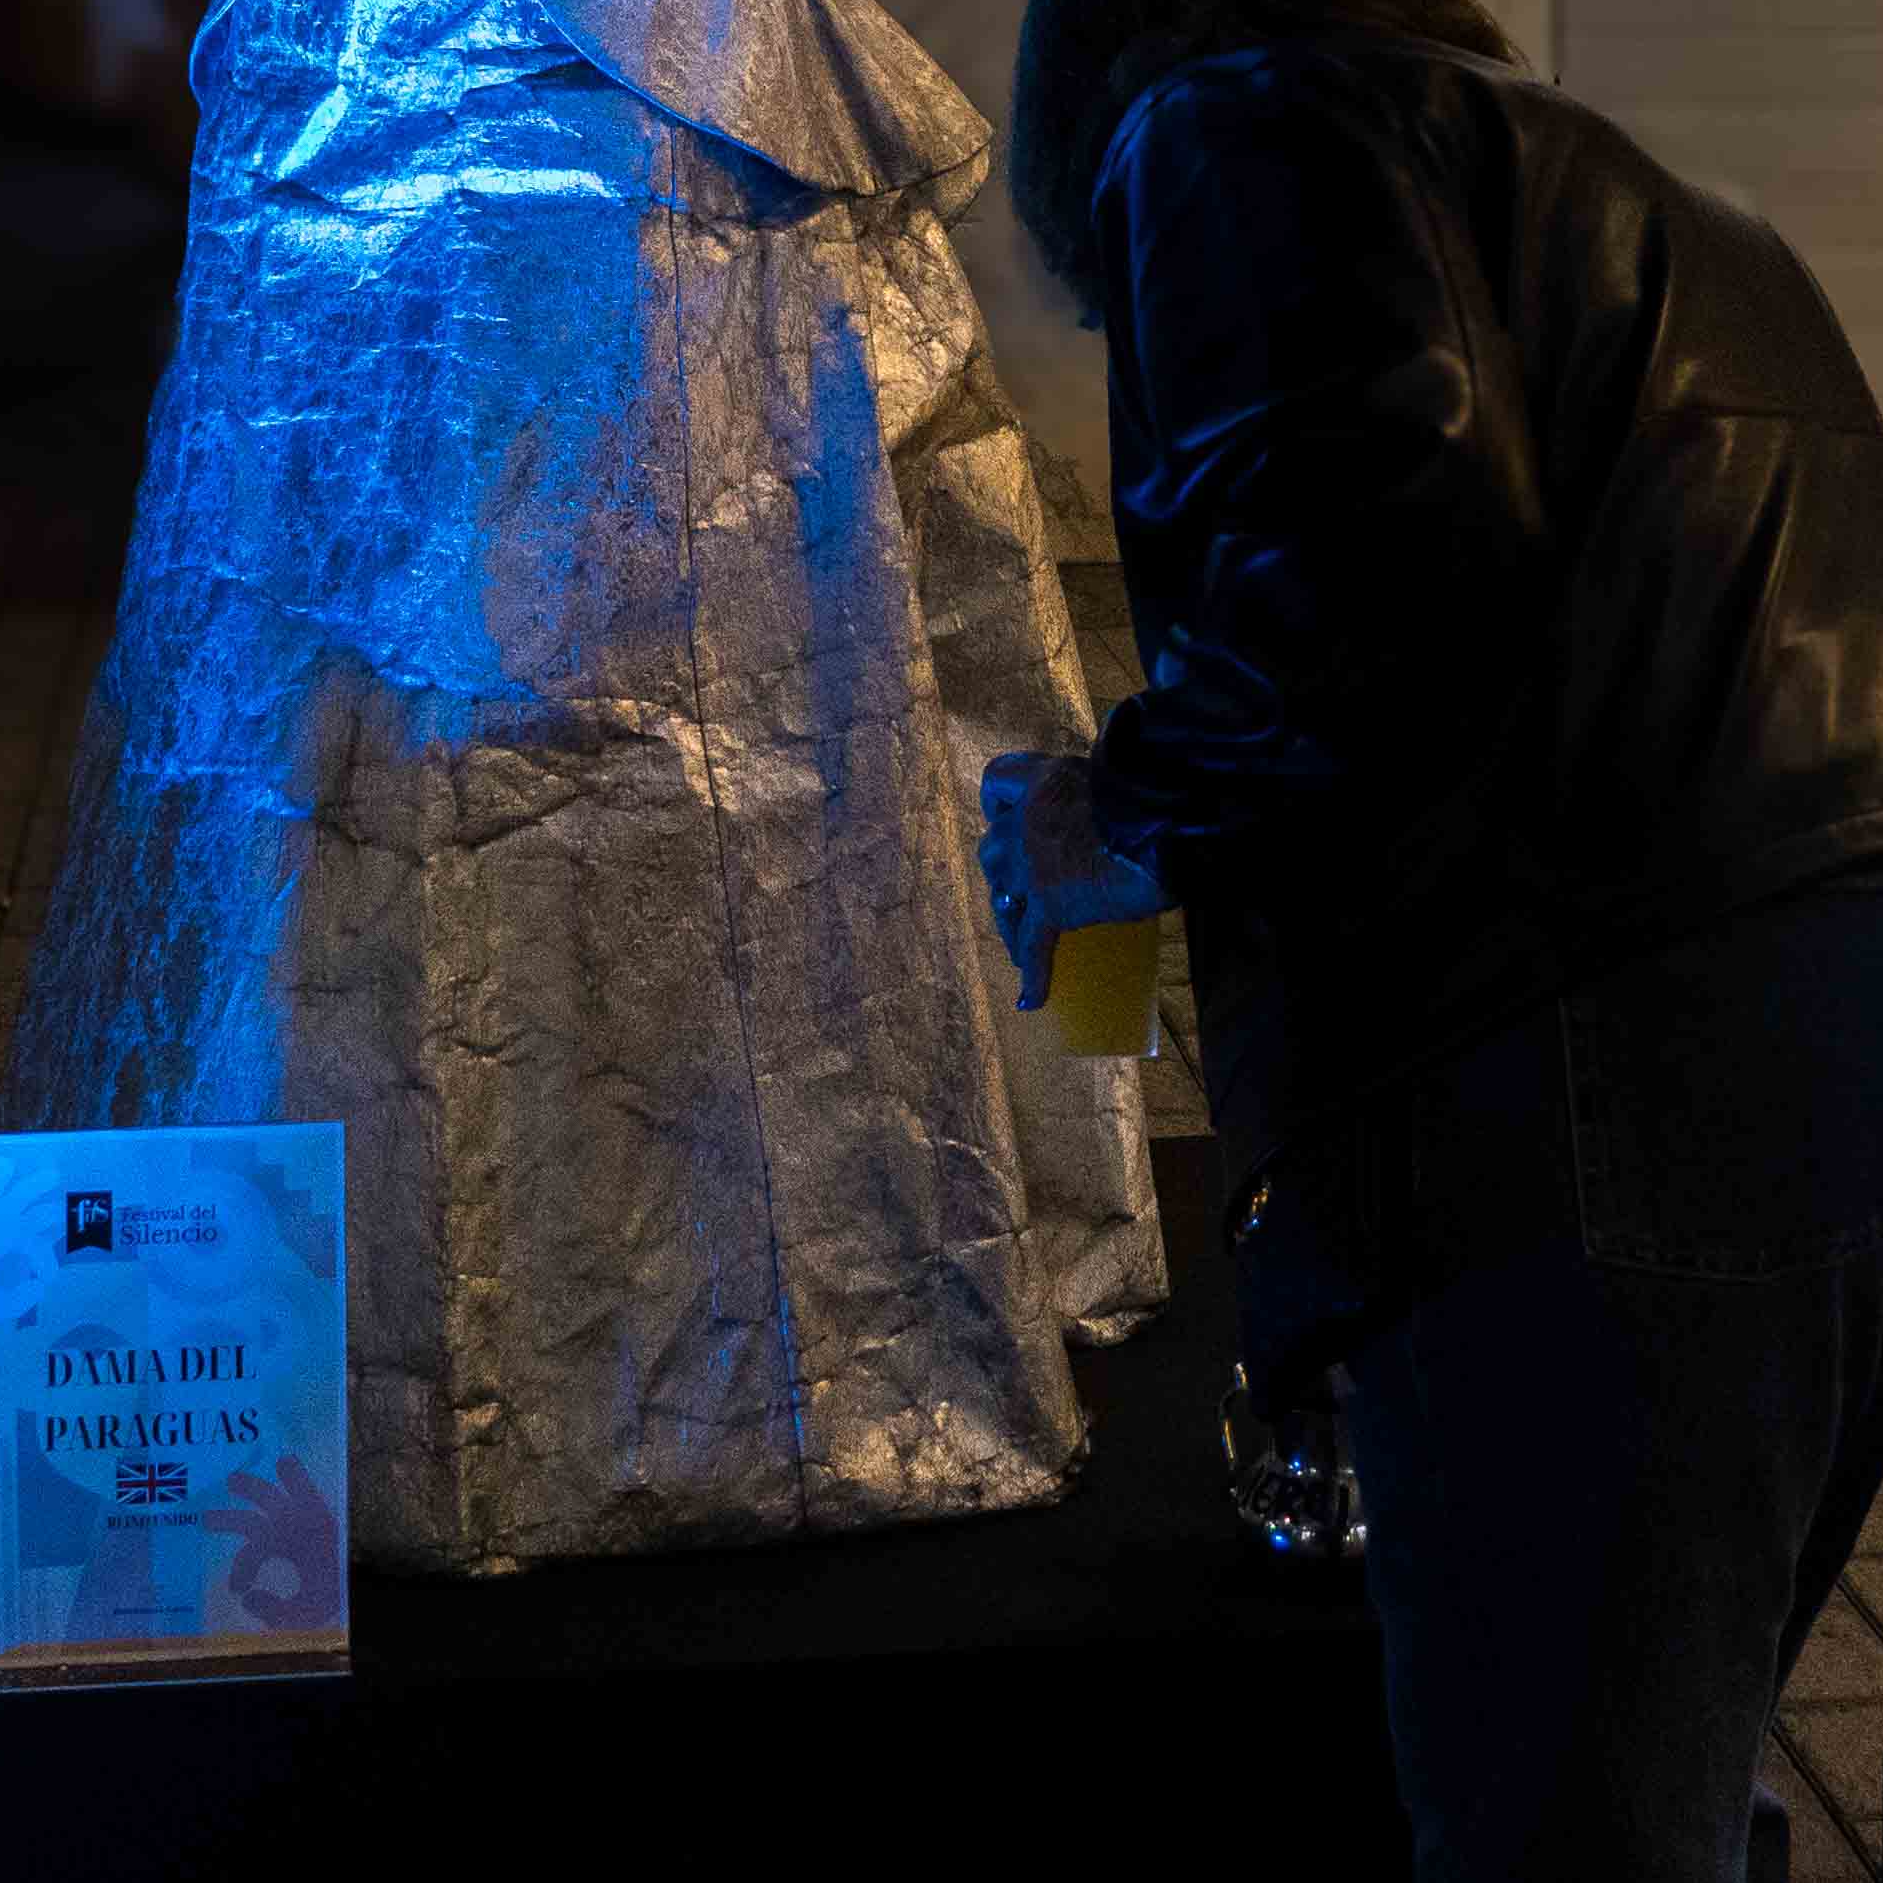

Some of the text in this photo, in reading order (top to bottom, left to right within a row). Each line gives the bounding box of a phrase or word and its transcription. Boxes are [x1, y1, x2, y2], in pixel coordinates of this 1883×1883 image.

[122, 1203, 217, 1222] Festival del
[119, 1223, 218, 1246] Silencio
[47, 1344, 259, 1388] DAMA DEL
[46, 1407, 259, 1451] PARAGUAS
